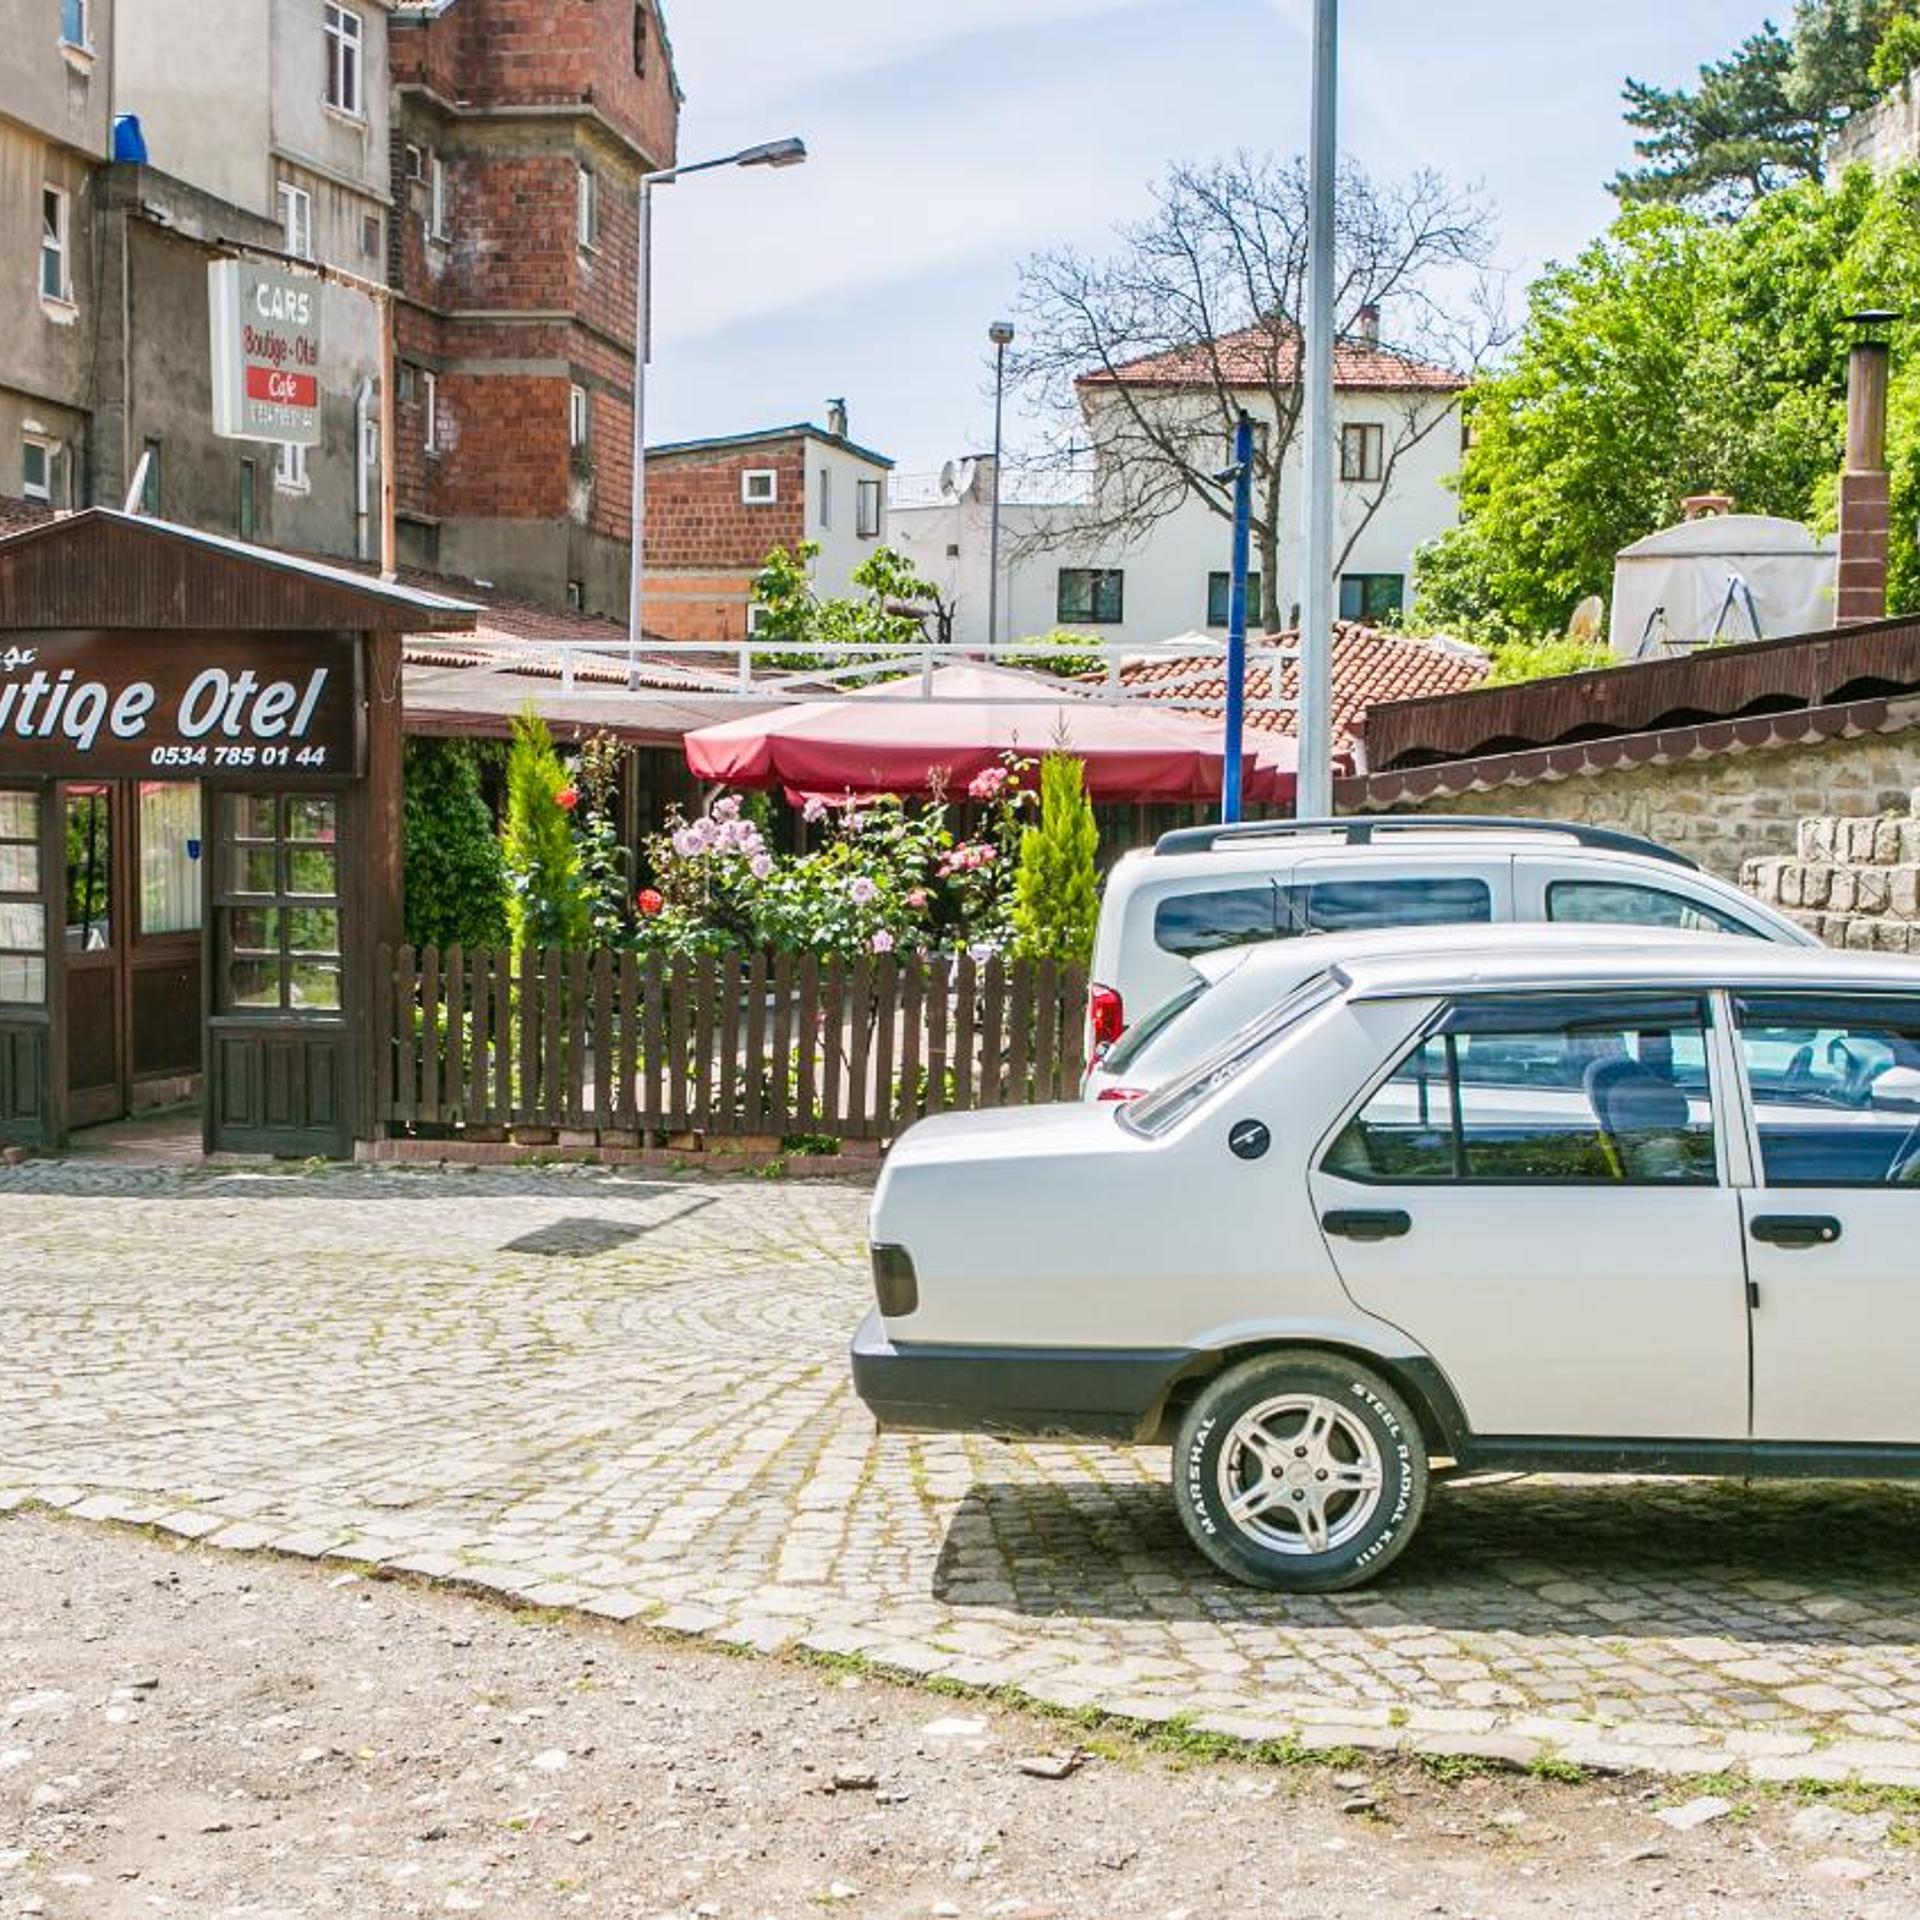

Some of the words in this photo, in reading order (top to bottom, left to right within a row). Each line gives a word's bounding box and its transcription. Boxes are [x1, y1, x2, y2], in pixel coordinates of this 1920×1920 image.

[257, 284, 310, 324] CARS
[268, 372, 297, 404] Cafe
[178, 668, 329, 738] Otel
[151, 747, 207, 765] 0534
[214, 747, 256, 765] 785
[262, 747, 288, 765] 01
[296, 747, 327, 765] 44
[1188, 1417, 1217, 1536] MARSHAL
[1350, 1383, 1401, 1439] STEEL
[1390, 1445, 1415, 1523] RADIAL
